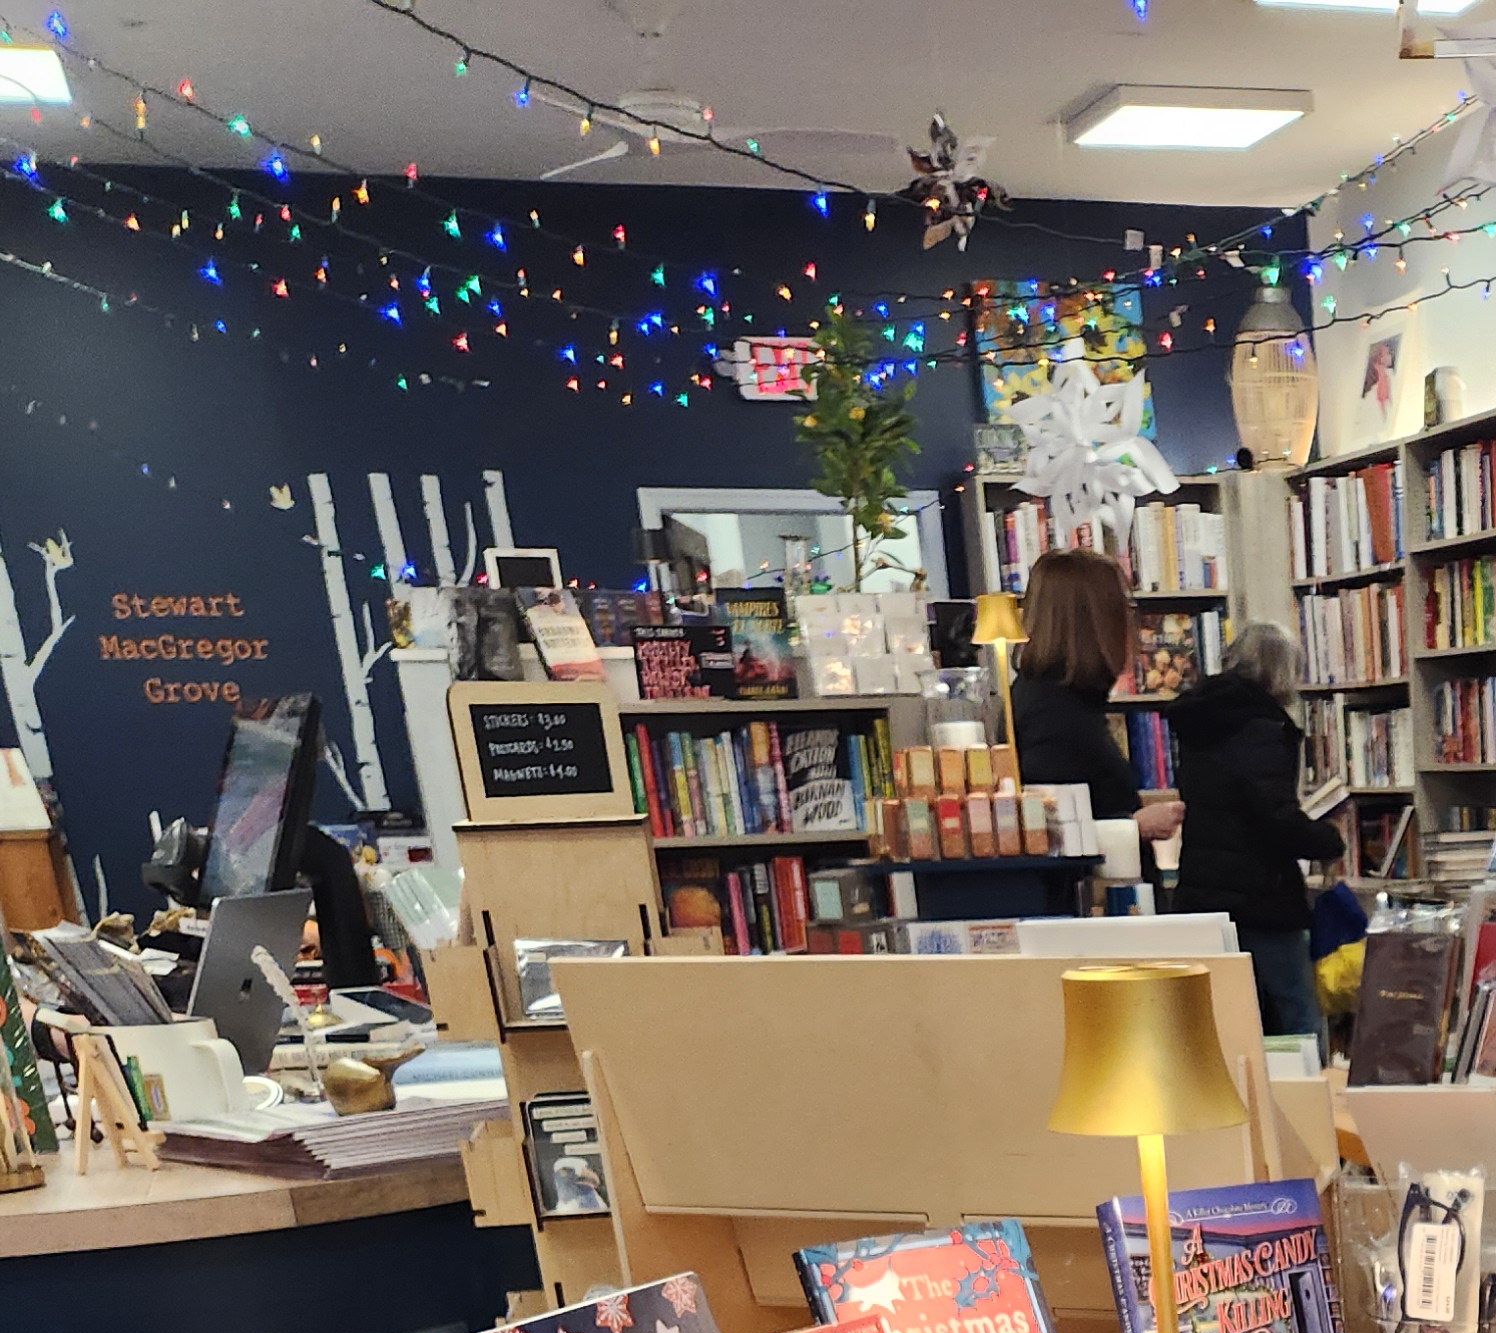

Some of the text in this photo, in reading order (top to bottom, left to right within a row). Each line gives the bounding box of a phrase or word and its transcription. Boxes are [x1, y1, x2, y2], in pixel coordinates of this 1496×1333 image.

[112, 592, 245, 620] Stewart
[98, 634, 269, 666] MacGregor
[143, 677, 241, 704] Grove
[1181, 1223, 1203, 1266] A
[1254, 1228, 1318, 1278] CANDY
[902, 1274, 955, 1299] The
